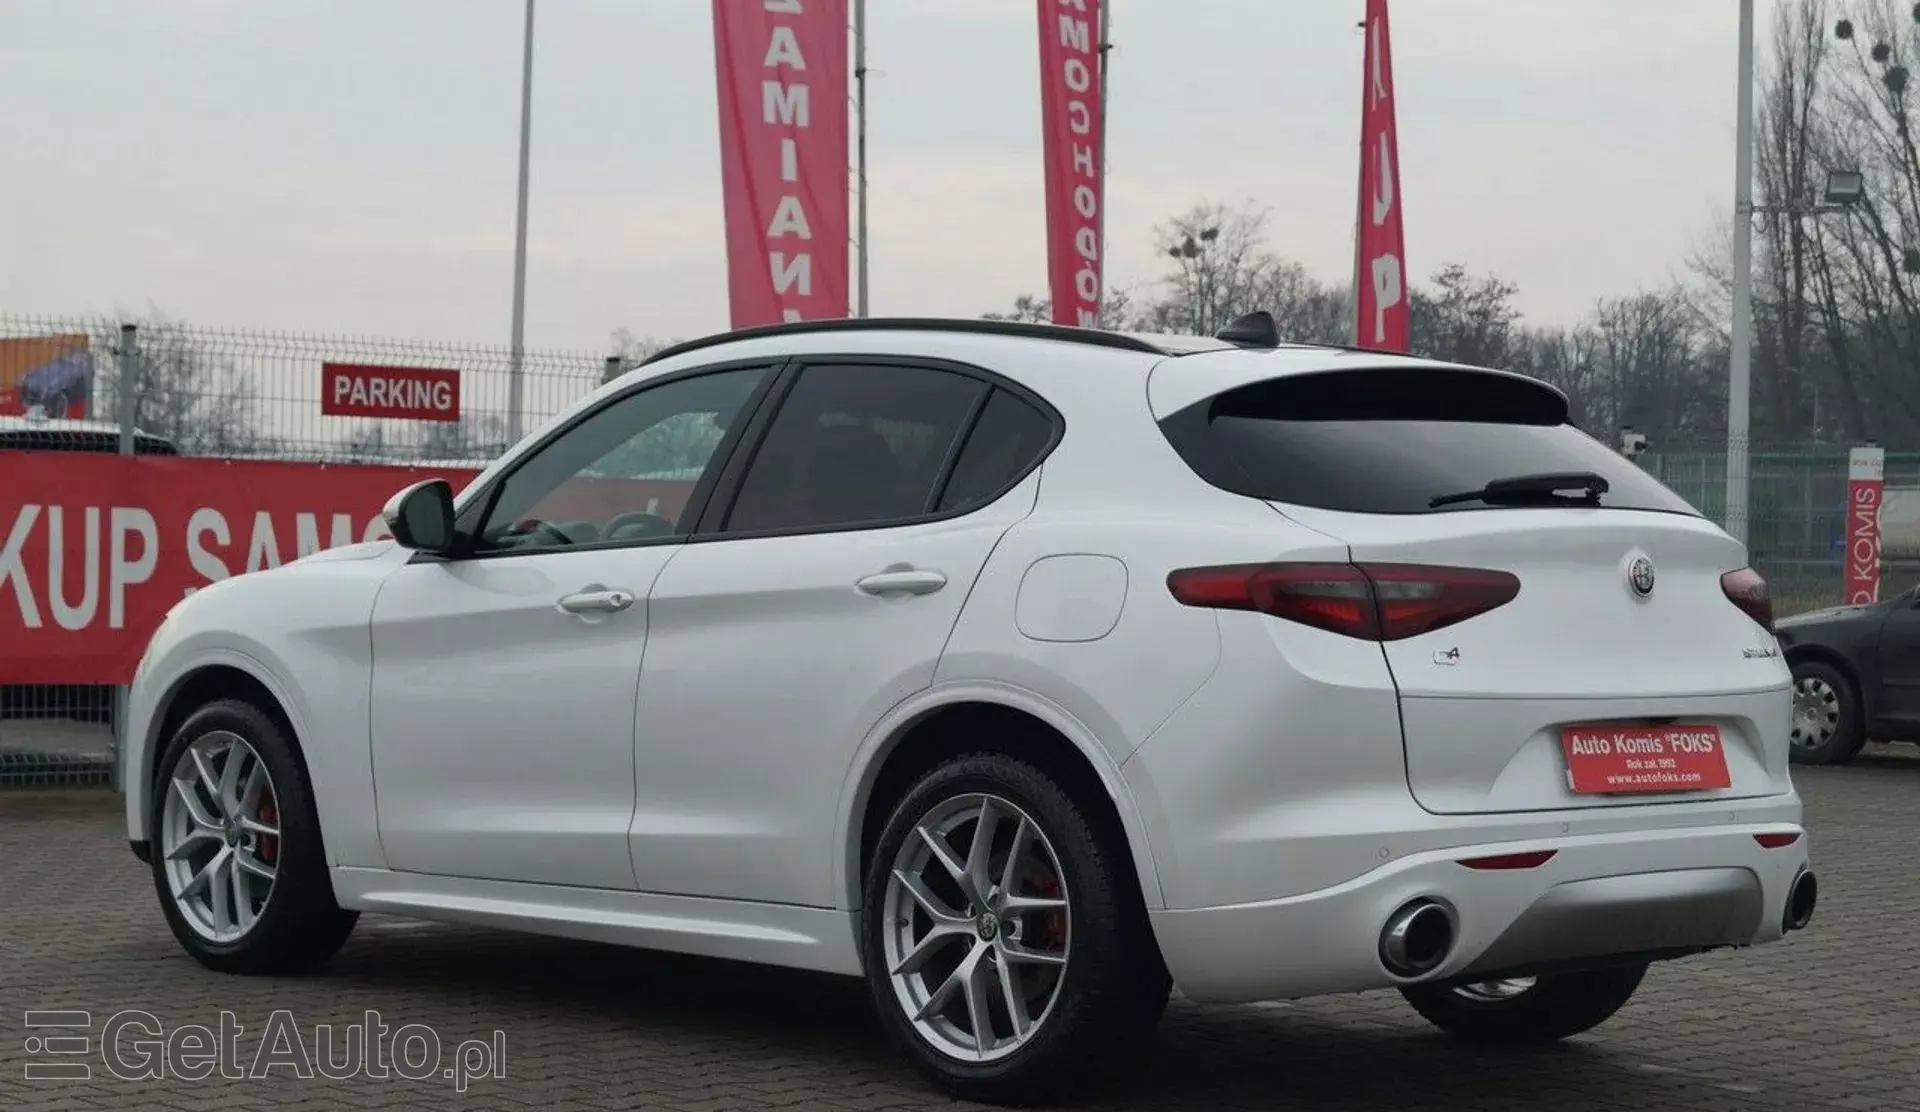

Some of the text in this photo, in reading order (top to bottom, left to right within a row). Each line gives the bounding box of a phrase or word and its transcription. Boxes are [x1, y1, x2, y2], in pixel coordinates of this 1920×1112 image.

[334, 375, 452, 410] PARKING
[1853, 487, 1876, 581] KOMIS
[1572, 735, 1611, 755] Auto
[1614, 734, 1663, 753] Komis
[1606, 773, 1702, 785] www.autofoks.com
